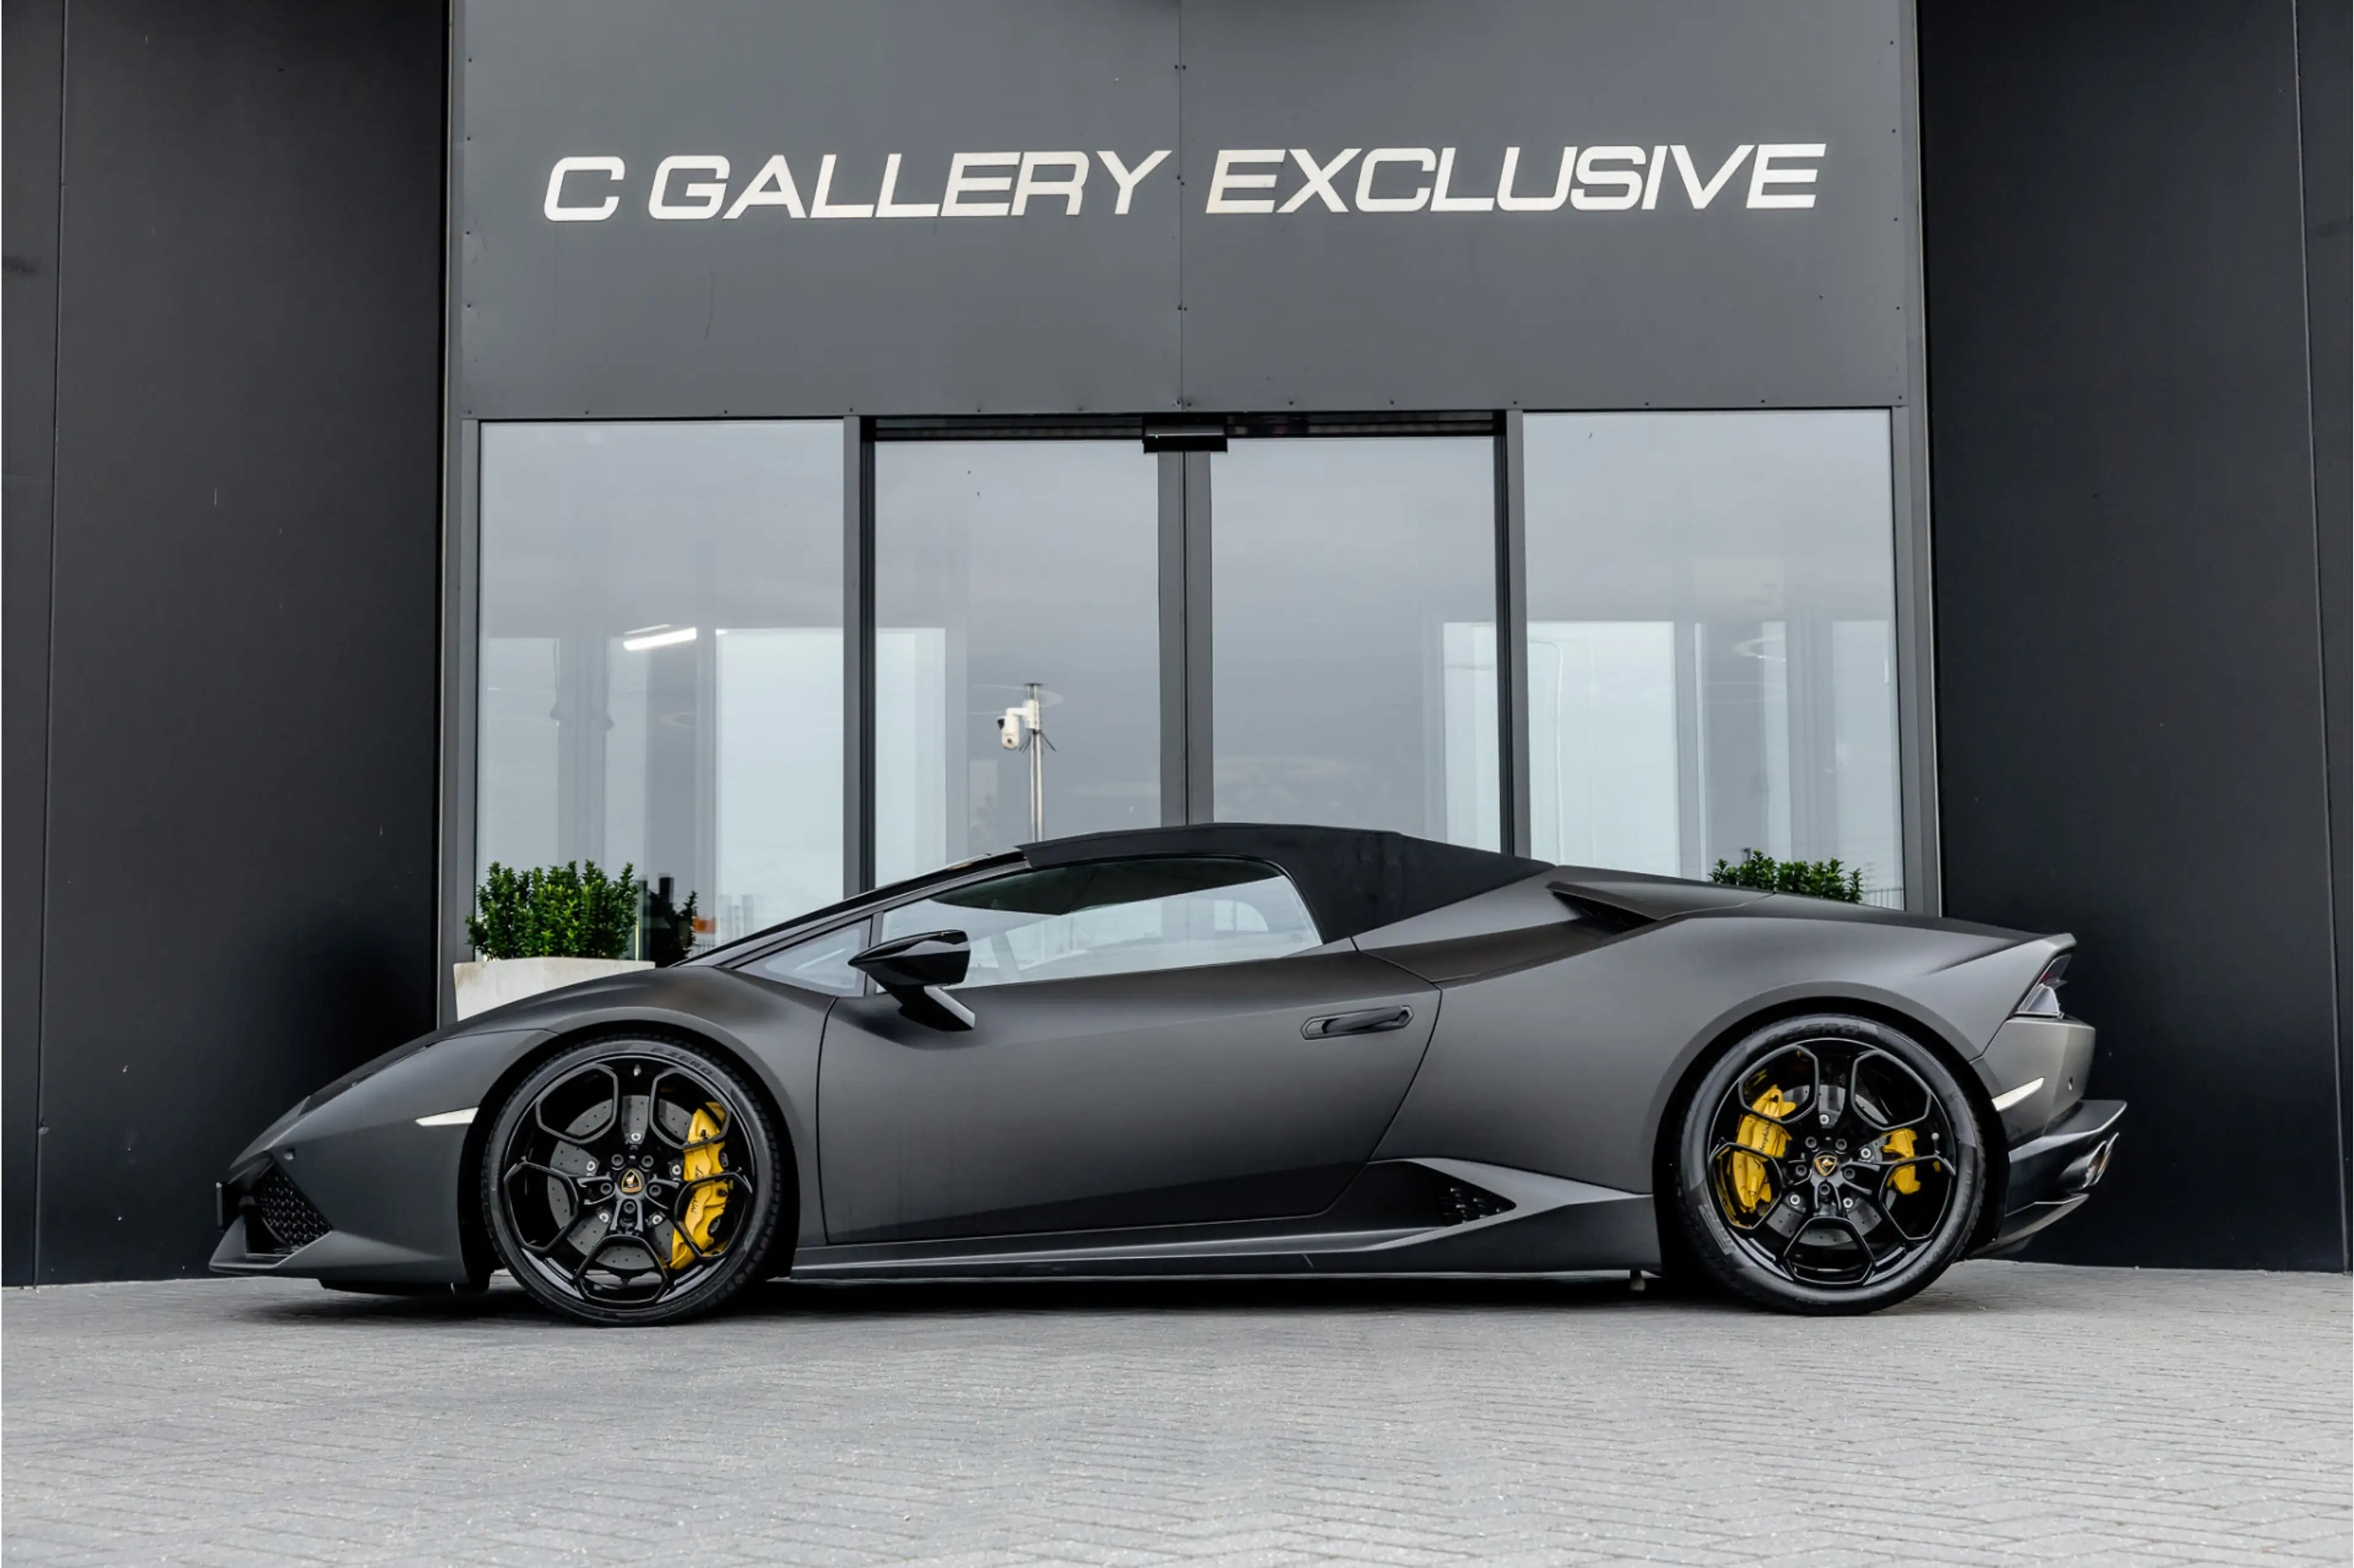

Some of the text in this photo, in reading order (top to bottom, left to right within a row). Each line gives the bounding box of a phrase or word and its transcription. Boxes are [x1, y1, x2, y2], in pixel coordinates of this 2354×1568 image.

[544, 143, 1827, 221] C GALLERY EXCLUSIVE
